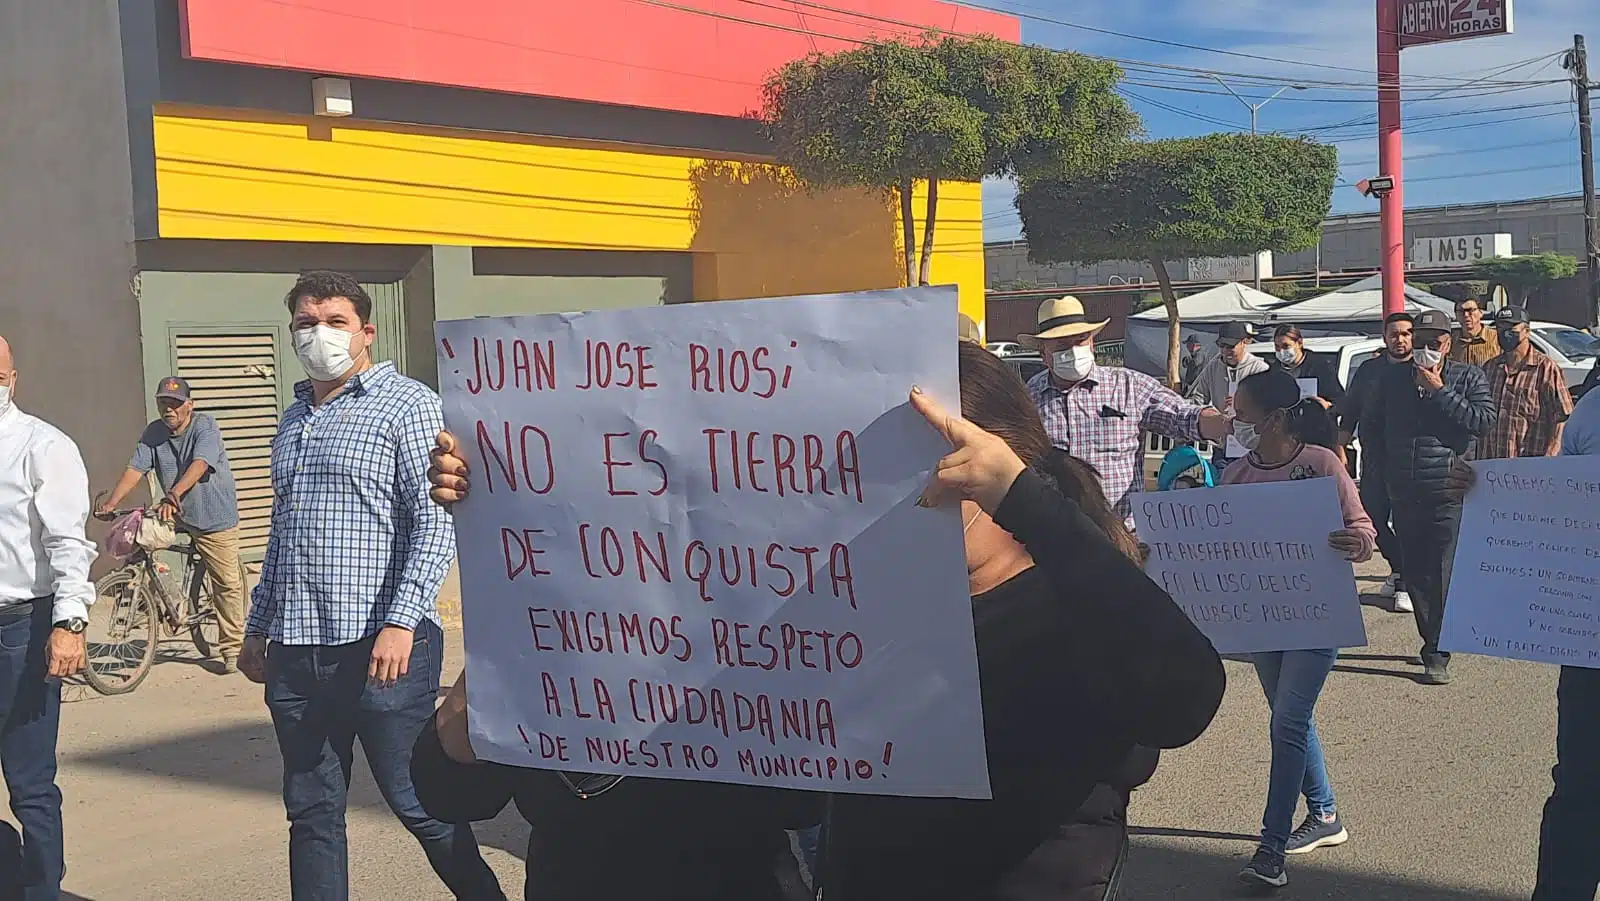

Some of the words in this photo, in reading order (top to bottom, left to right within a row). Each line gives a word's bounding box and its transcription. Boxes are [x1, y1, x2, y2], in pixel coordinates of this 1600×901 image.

[1402, 0, 1447, 34] ABIERTO
[1450, 0, 1500, 20] 24
[1450, 17, 1500, 33] HORAS
[1428, 236, 1483, 262] IMSS
[575, 338, 658, 391] JOSE
[475, 419, 556, 495] NO
[602, 428, 670, 497] ES
[702, 427, 864, 504] TIERRA
[500, 527, 552, 581] DE
[578, 523, 858, 611] CONQUISTA
[1257, 573, 1279, 593] DE
[1283, 572, 1312, 593] LOS
[1261, 602, 1331, 623] PUBLICOS
[528, 606, 692, 662] EXIGIMOS
[711, 617, 864, 673] RESPETO
[628, 678, 837, 749] CIUDADANIA
[586, 735, 719, 771] NUESTRO
